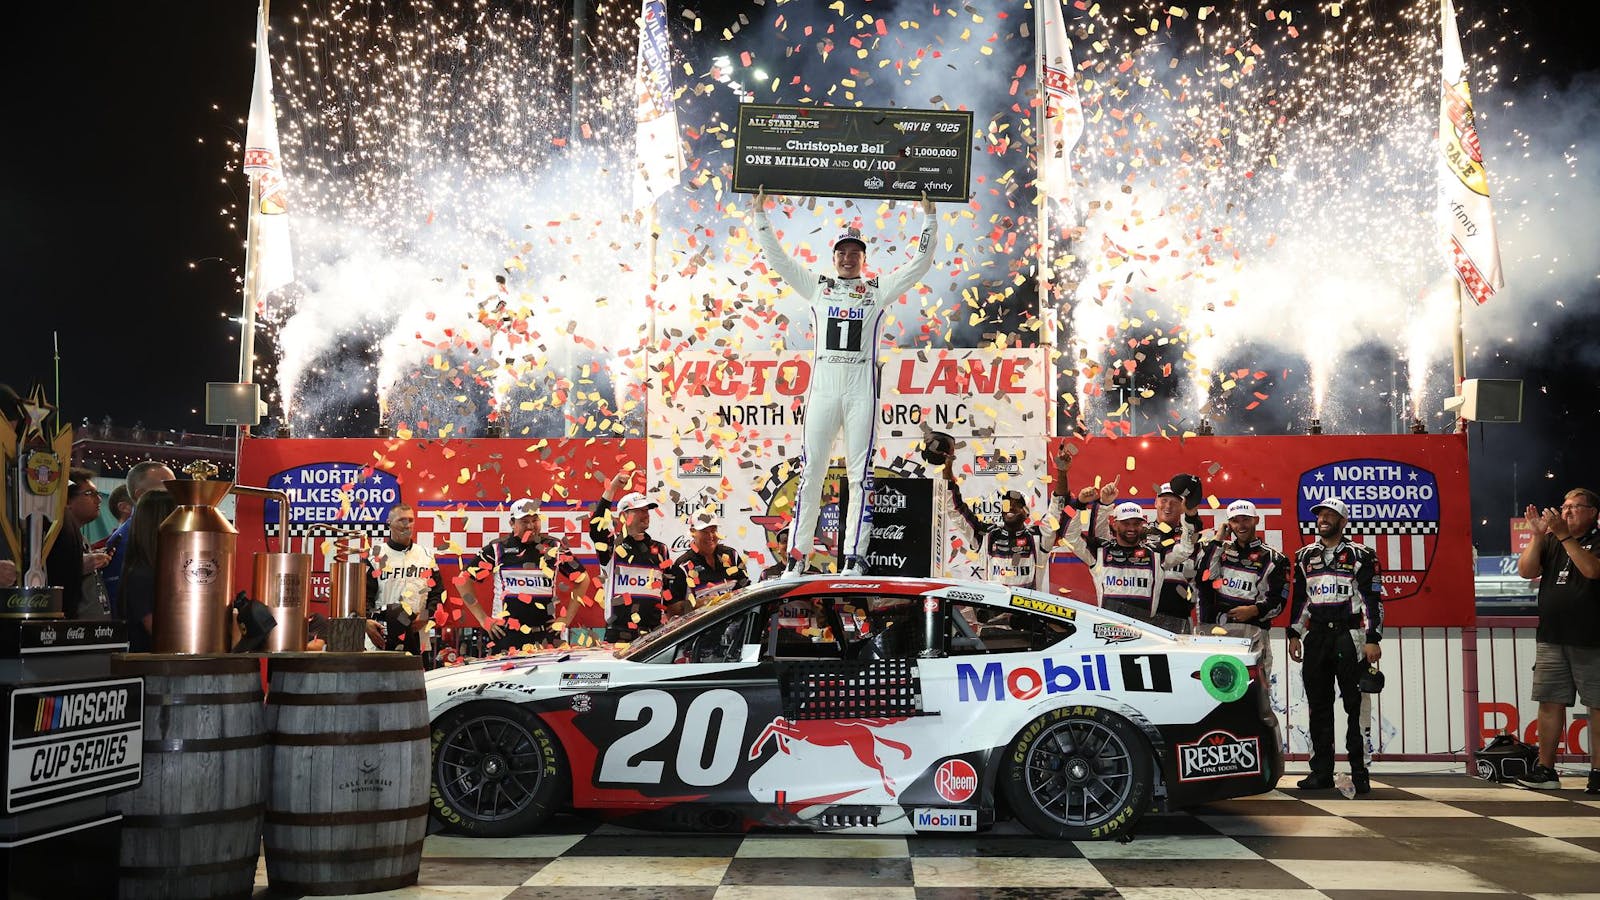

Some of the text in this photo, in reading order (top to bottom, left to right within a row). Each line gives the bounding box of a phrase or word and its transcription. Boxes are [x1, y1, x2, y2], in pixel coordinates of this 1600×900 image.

[793, 120, 820, 129] RACE
[899, 121, 920, 132] MAY
[920, 122, 931, 132] 18
[786, 140, 859, 154] Christopher
[861, 143, 884, 154] Bell
[905, 146, 957, 157] $ 1,000,000
[745, 154, 772, 166] ONE
[774, 156, 829, 168] MILLION
[832, 160, 850, 168] AND
[924, 180, 953, 192] xfinity
[828, 306, 864, 319] Mobil
[661, 359, 1031, 396] VICTO LANE
[719, 405, 784, 425] NORTH
[1333, 466, 1402, 481] NORTH
[1302, 485, 1433, 501] WILKESBORO
[874, 494, 907, 509] USCH
[675, 503, 724, 517] BUH
[1347, 503, 1423, 519] EEDWAY
[870, 524, 907, 540] ca-Cola
[506, 576, 541, 587] Mobil
[617, 574, 649, 587] Mobi
[1106, 575, 1135, 586] Mobil
[1223, 578, 1241, 589] obil
[1381, 575, 1417, 583] ROLINA
[1309, 583, 1336, 596] Mobil
[779, 607, 799, 618] obil
[40, 630, 57, 641] BUSCH
[94, 625, 114, 638] xfinity
[956, 654, 1111, 702] Mobil
[59, 688, 128, 728] NASCAR
[599, 688, 749, 787] 20
[30, 734, 128, 782] CUP SERIES
[533, 728, 556, 776] EAGLE
[1184, 740, 1256, 777] RESER'S
[939, 762, 975, 796] Rheem
[918, 813, 957, 827] Mobil
[1091, 805, 1134, 838] EAGLE
